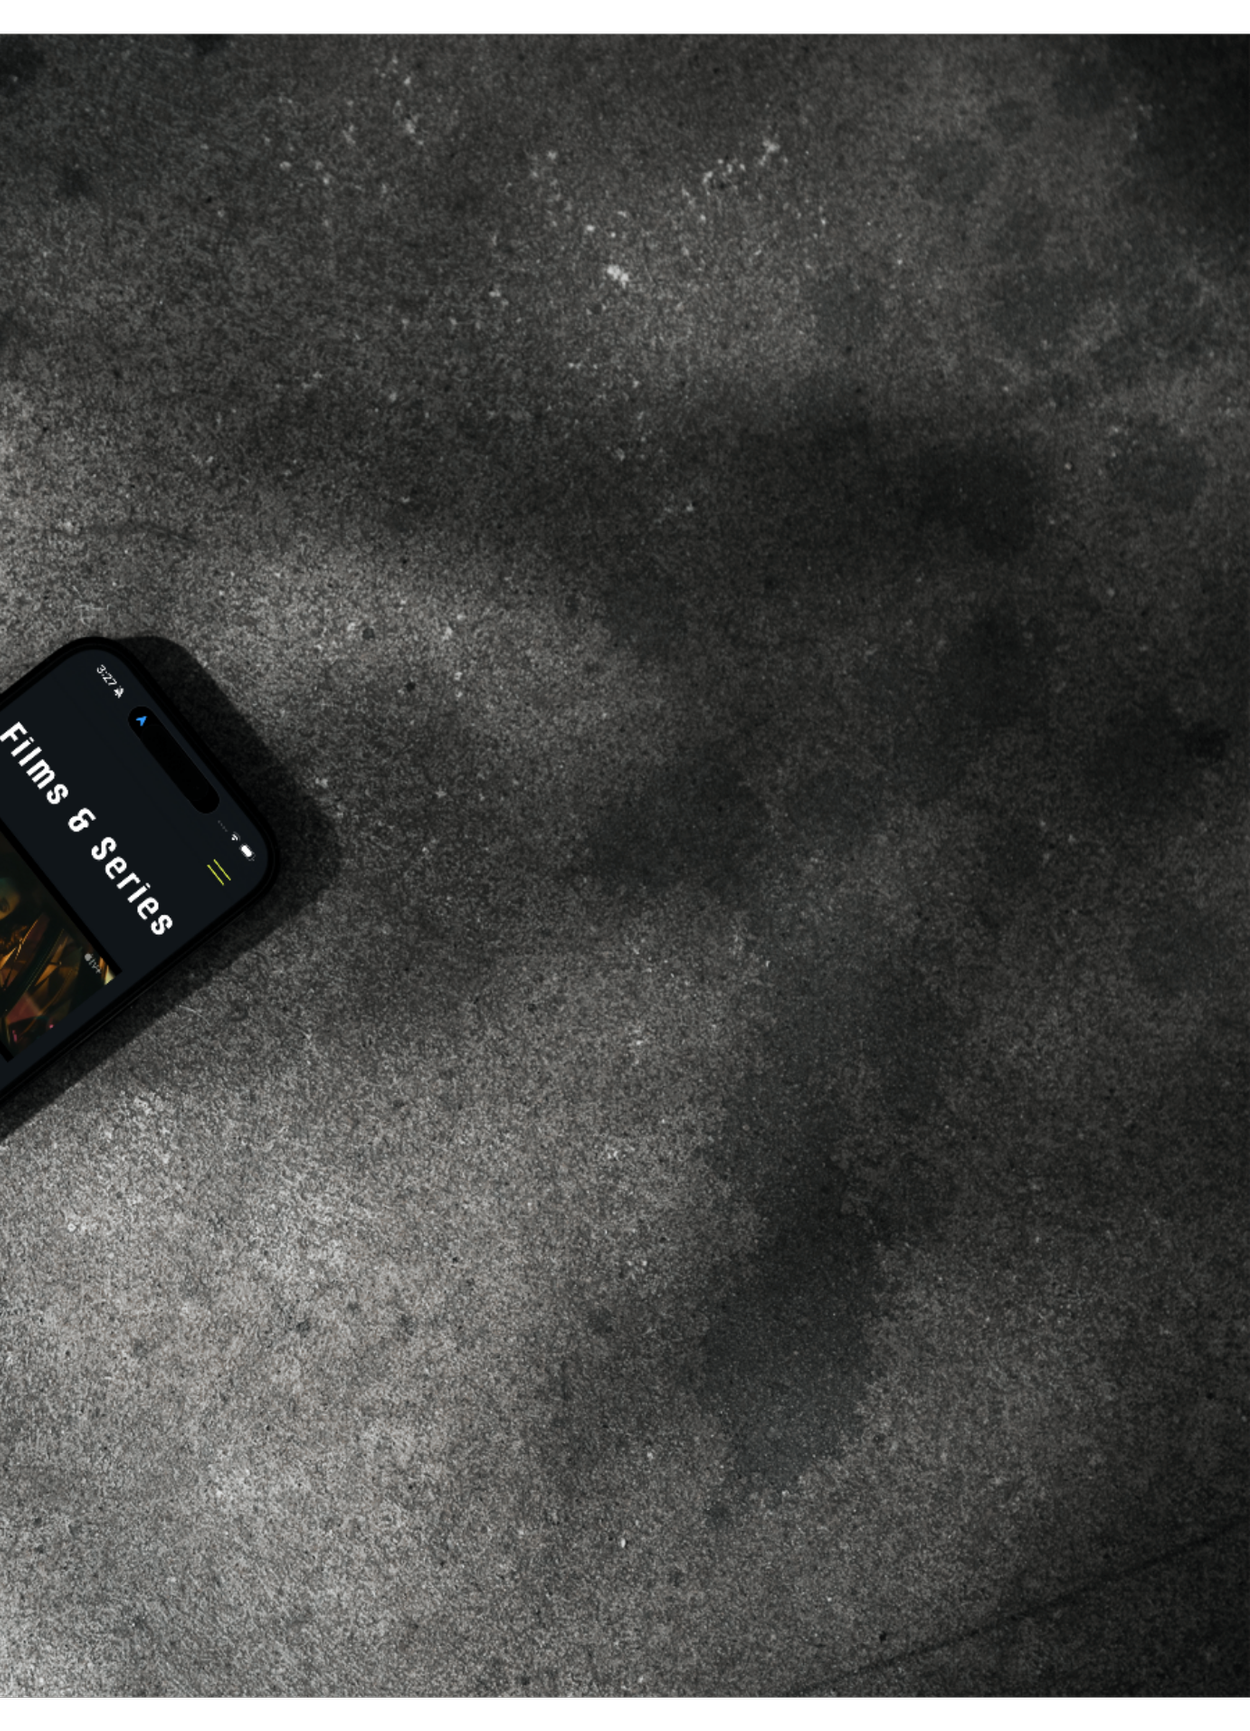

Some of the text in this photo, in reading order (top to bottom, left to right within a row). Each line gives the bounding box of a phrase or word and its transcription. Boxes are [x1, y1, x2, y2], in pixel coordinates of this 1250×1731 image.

[96, 664, 117, 686] 3:27
[0, 721, 173, 936] Films & Series
